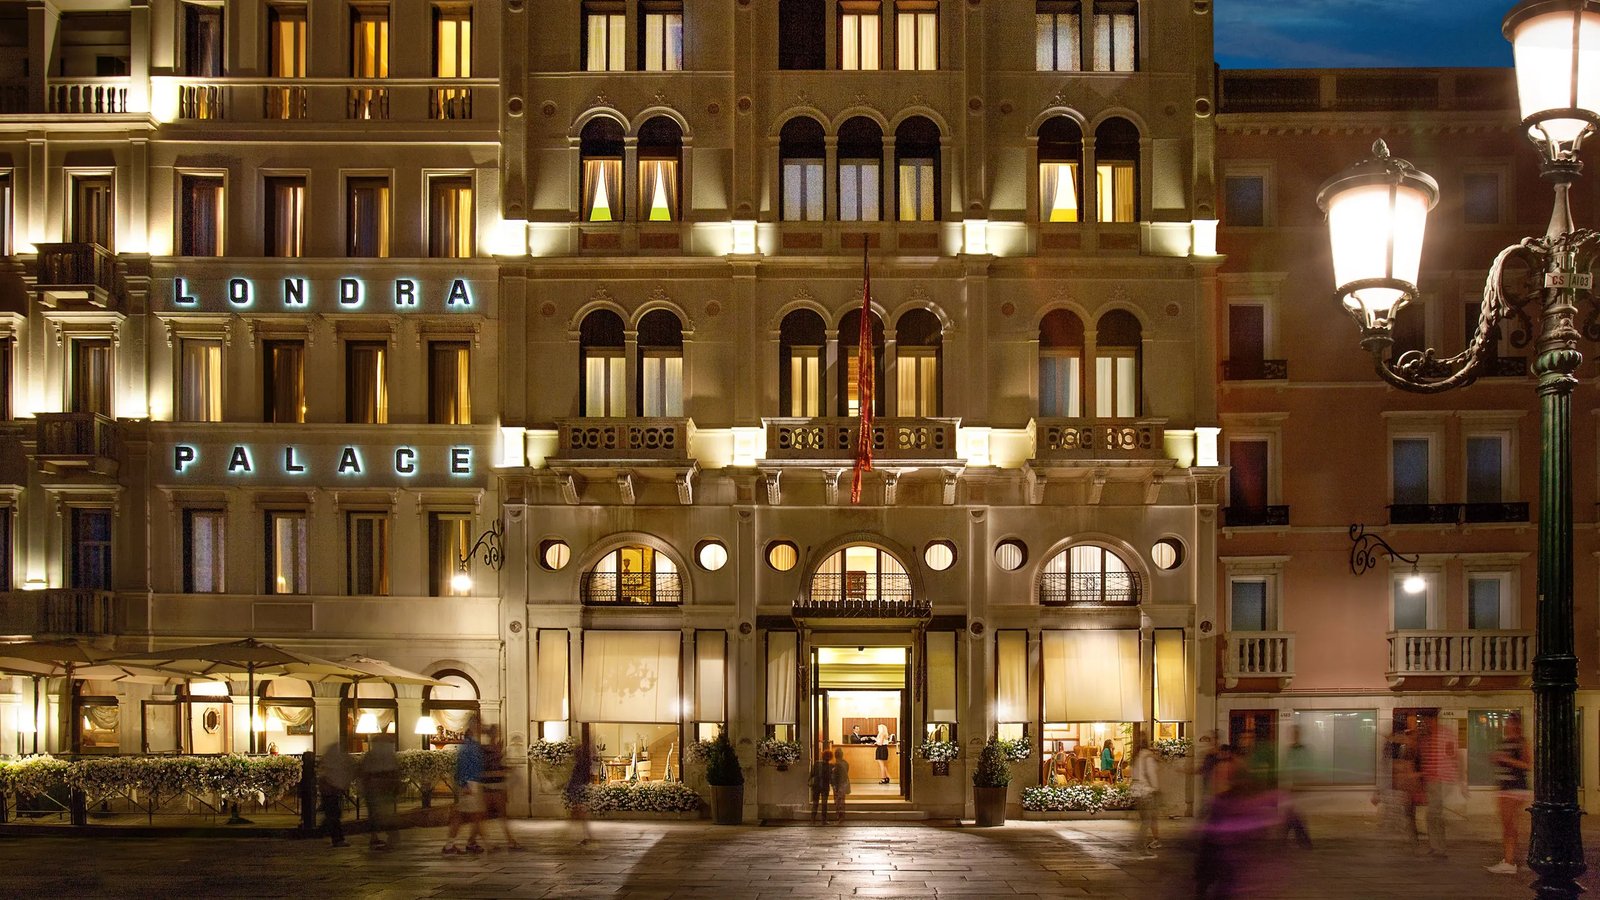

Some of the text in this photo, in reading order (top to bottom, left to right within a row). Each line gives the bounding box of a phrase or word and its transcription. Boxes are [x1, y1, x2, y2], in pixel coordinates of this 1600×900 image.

[174, 277, 471, 305] LONDRA
[1552, 275, 1565, 286] CS
[174, 446, 471, 474] PALACE
